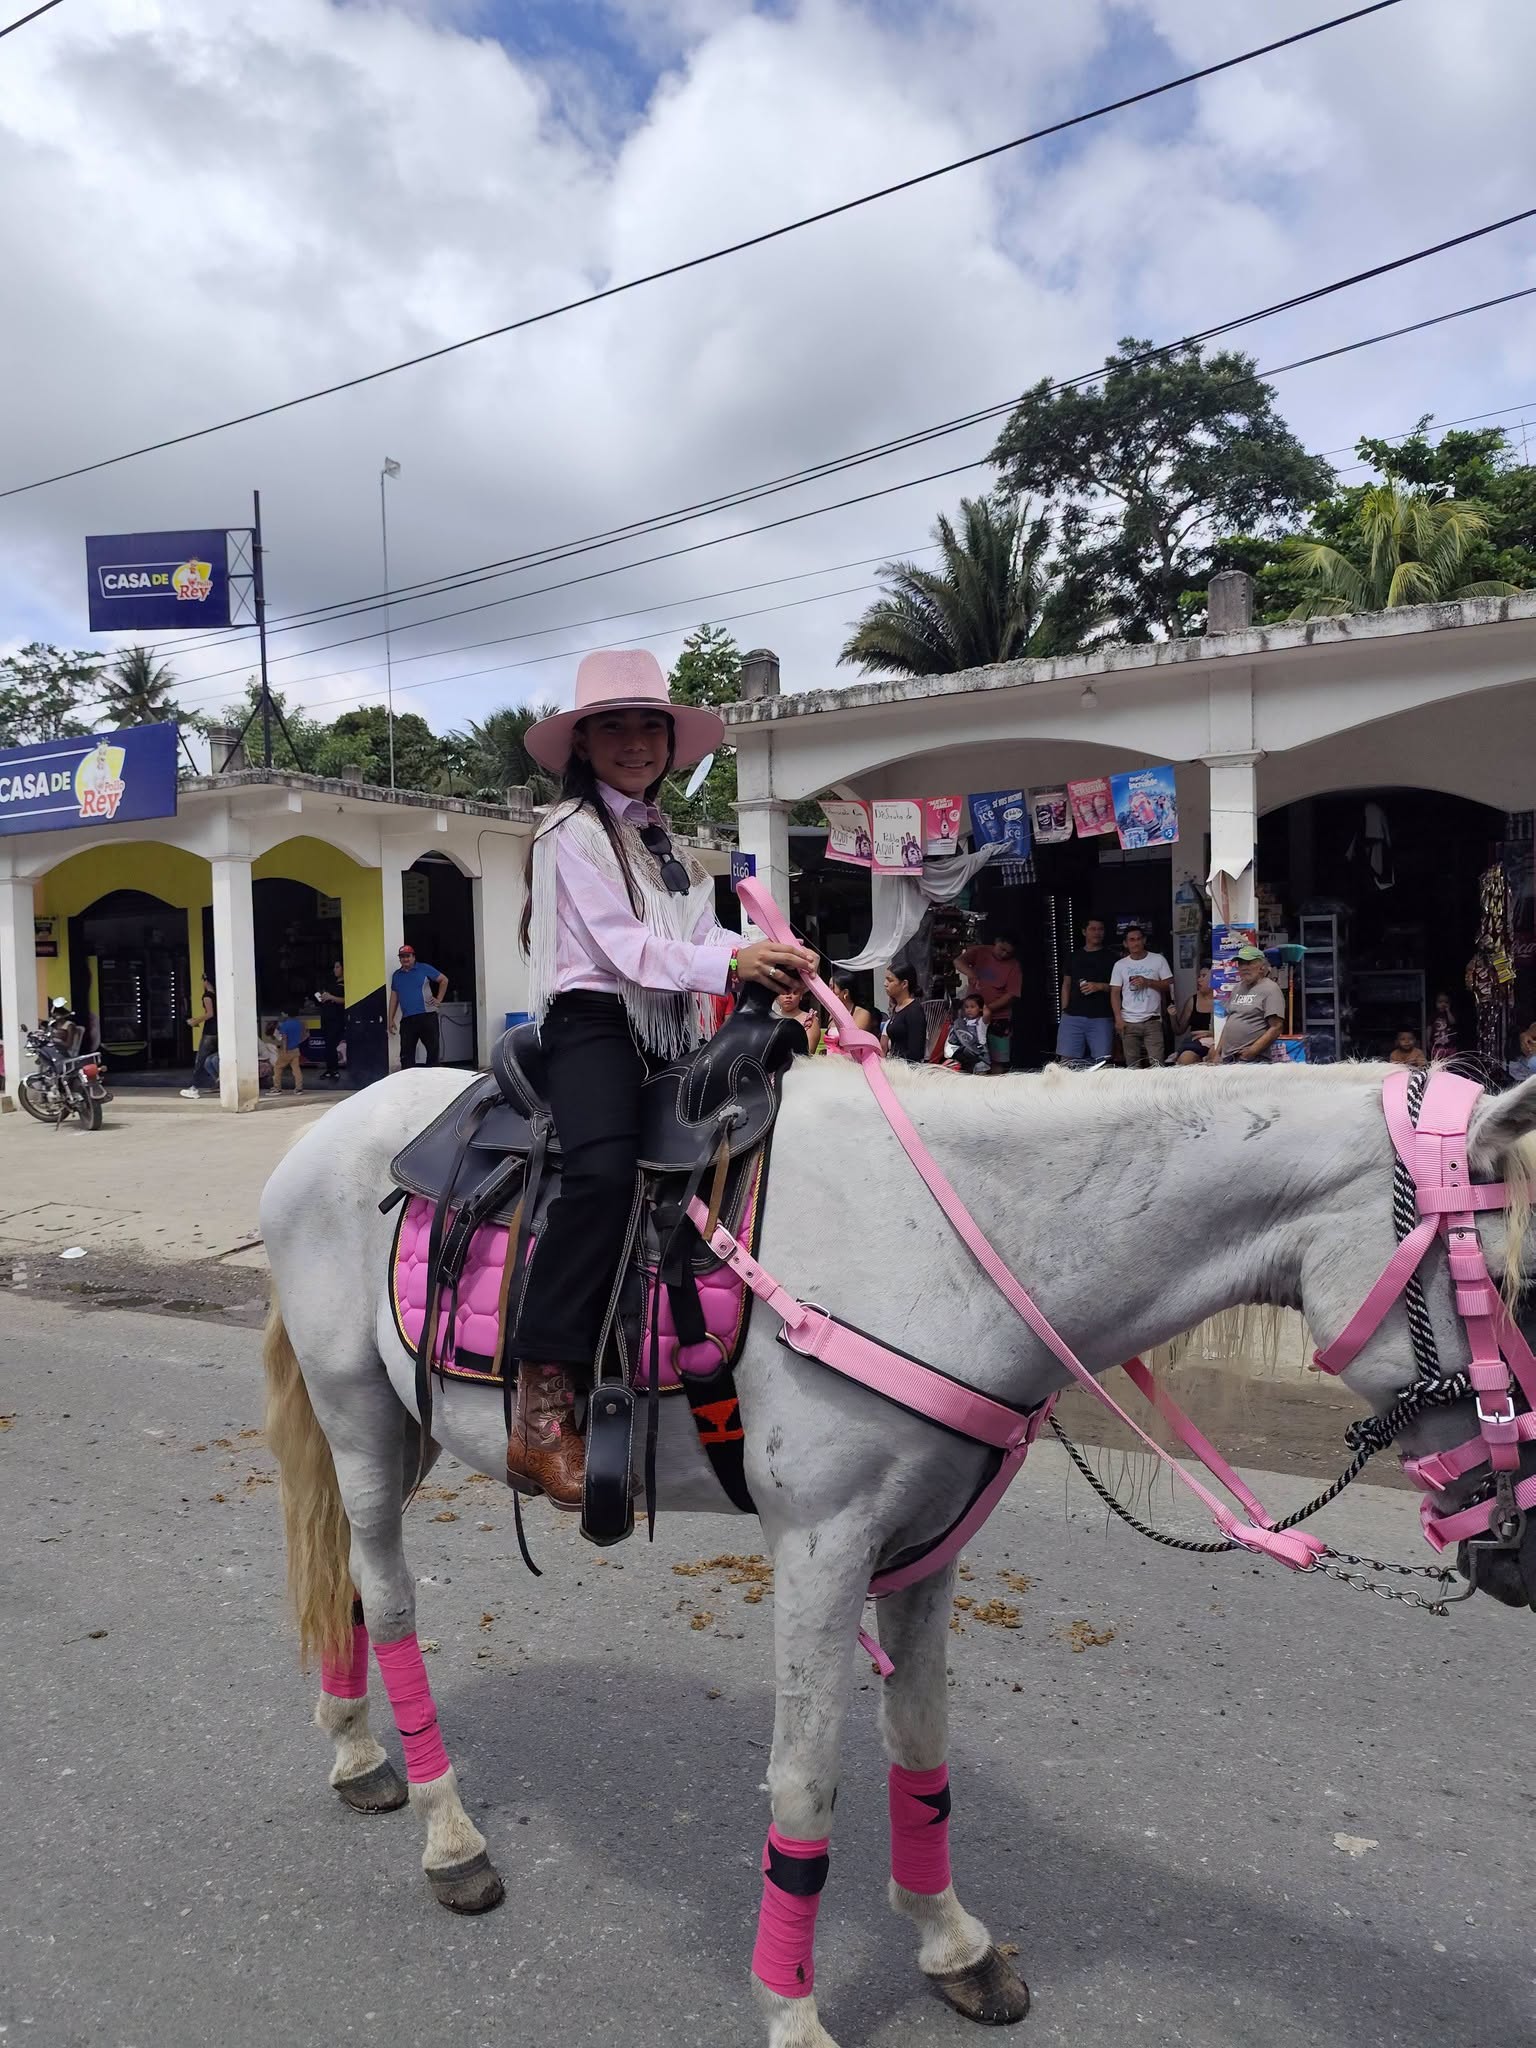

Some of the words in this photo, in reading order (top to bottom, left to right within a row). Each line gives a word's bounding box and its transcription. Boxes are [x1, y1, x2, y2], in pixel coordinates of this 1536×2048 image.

[104, 573, 151, 589] CASA
[152, 574, 169, 585] DE
[179, 584, 209, 599] Rey
[0, 772, 50, 803] CASA
[51, 771, 71, 792] DE
[82, 790, 119, 816] Rey
